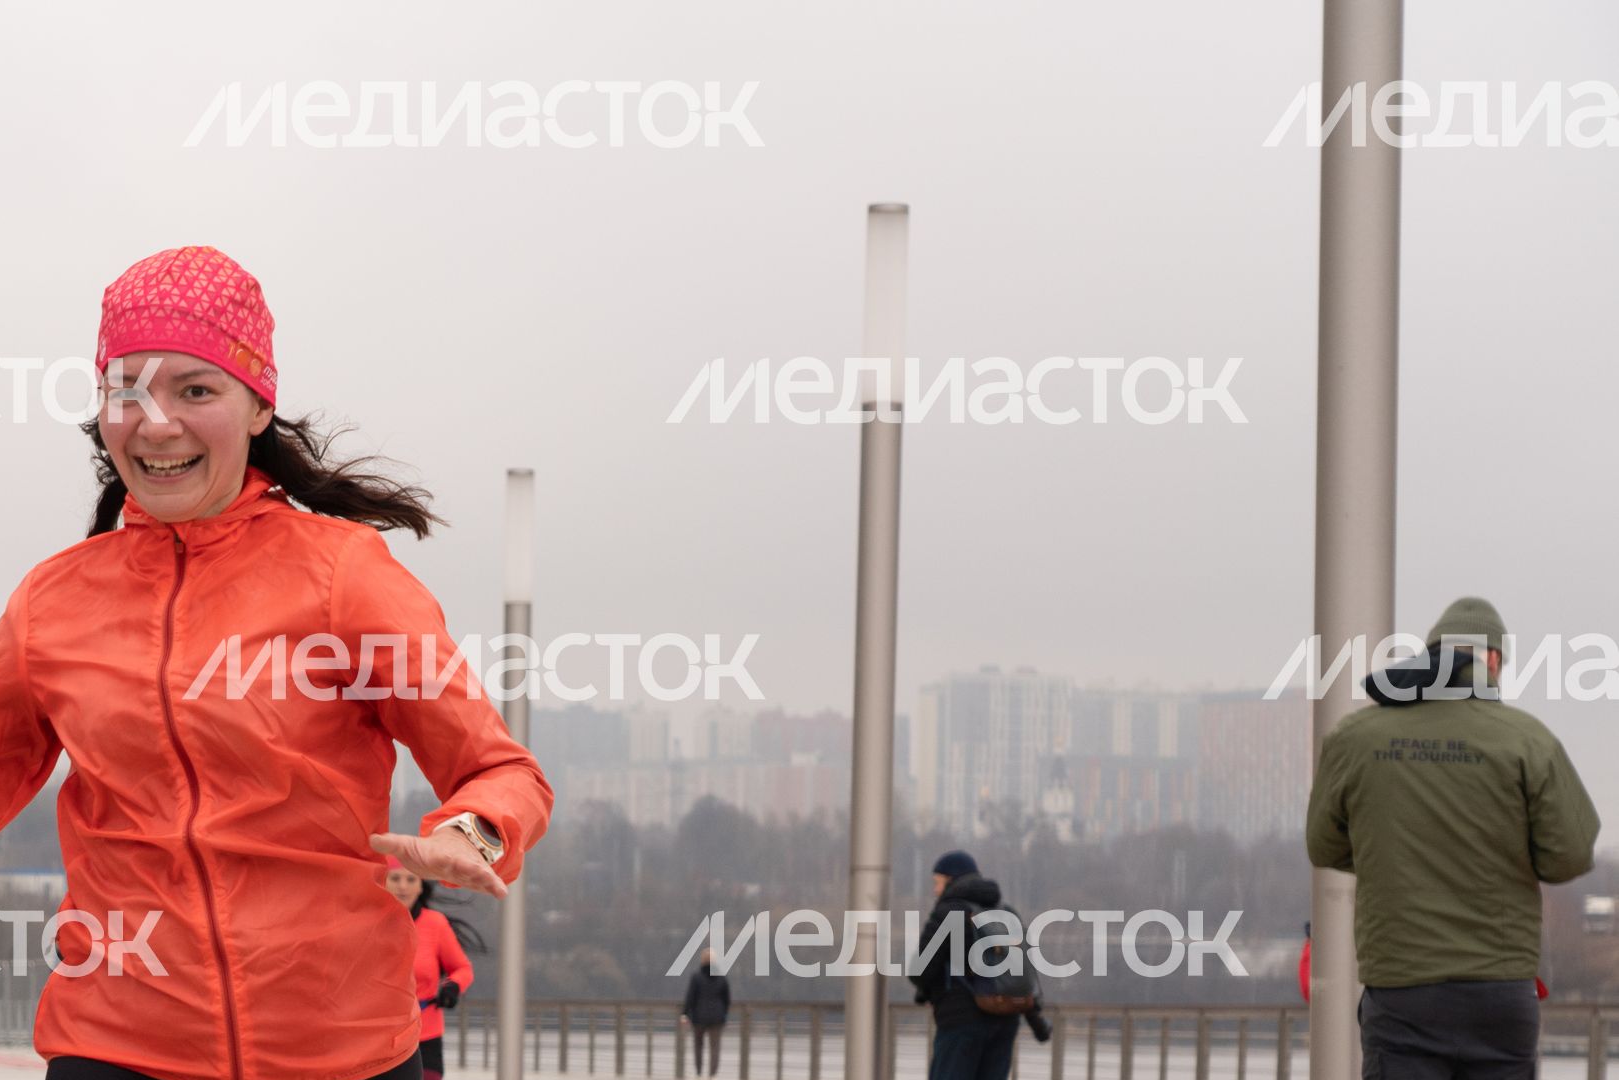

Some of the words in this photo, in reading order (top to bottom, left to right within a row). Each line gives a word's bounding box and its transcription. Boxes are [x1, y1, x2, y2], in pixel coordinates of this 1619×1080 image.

[1389, 738, 1440, 750] PEACE
[1446, 739, 1467, 751] BE
[1373, 750, 1404, 761] THE
[1408, 750, 1485, 764] JOURNEY
